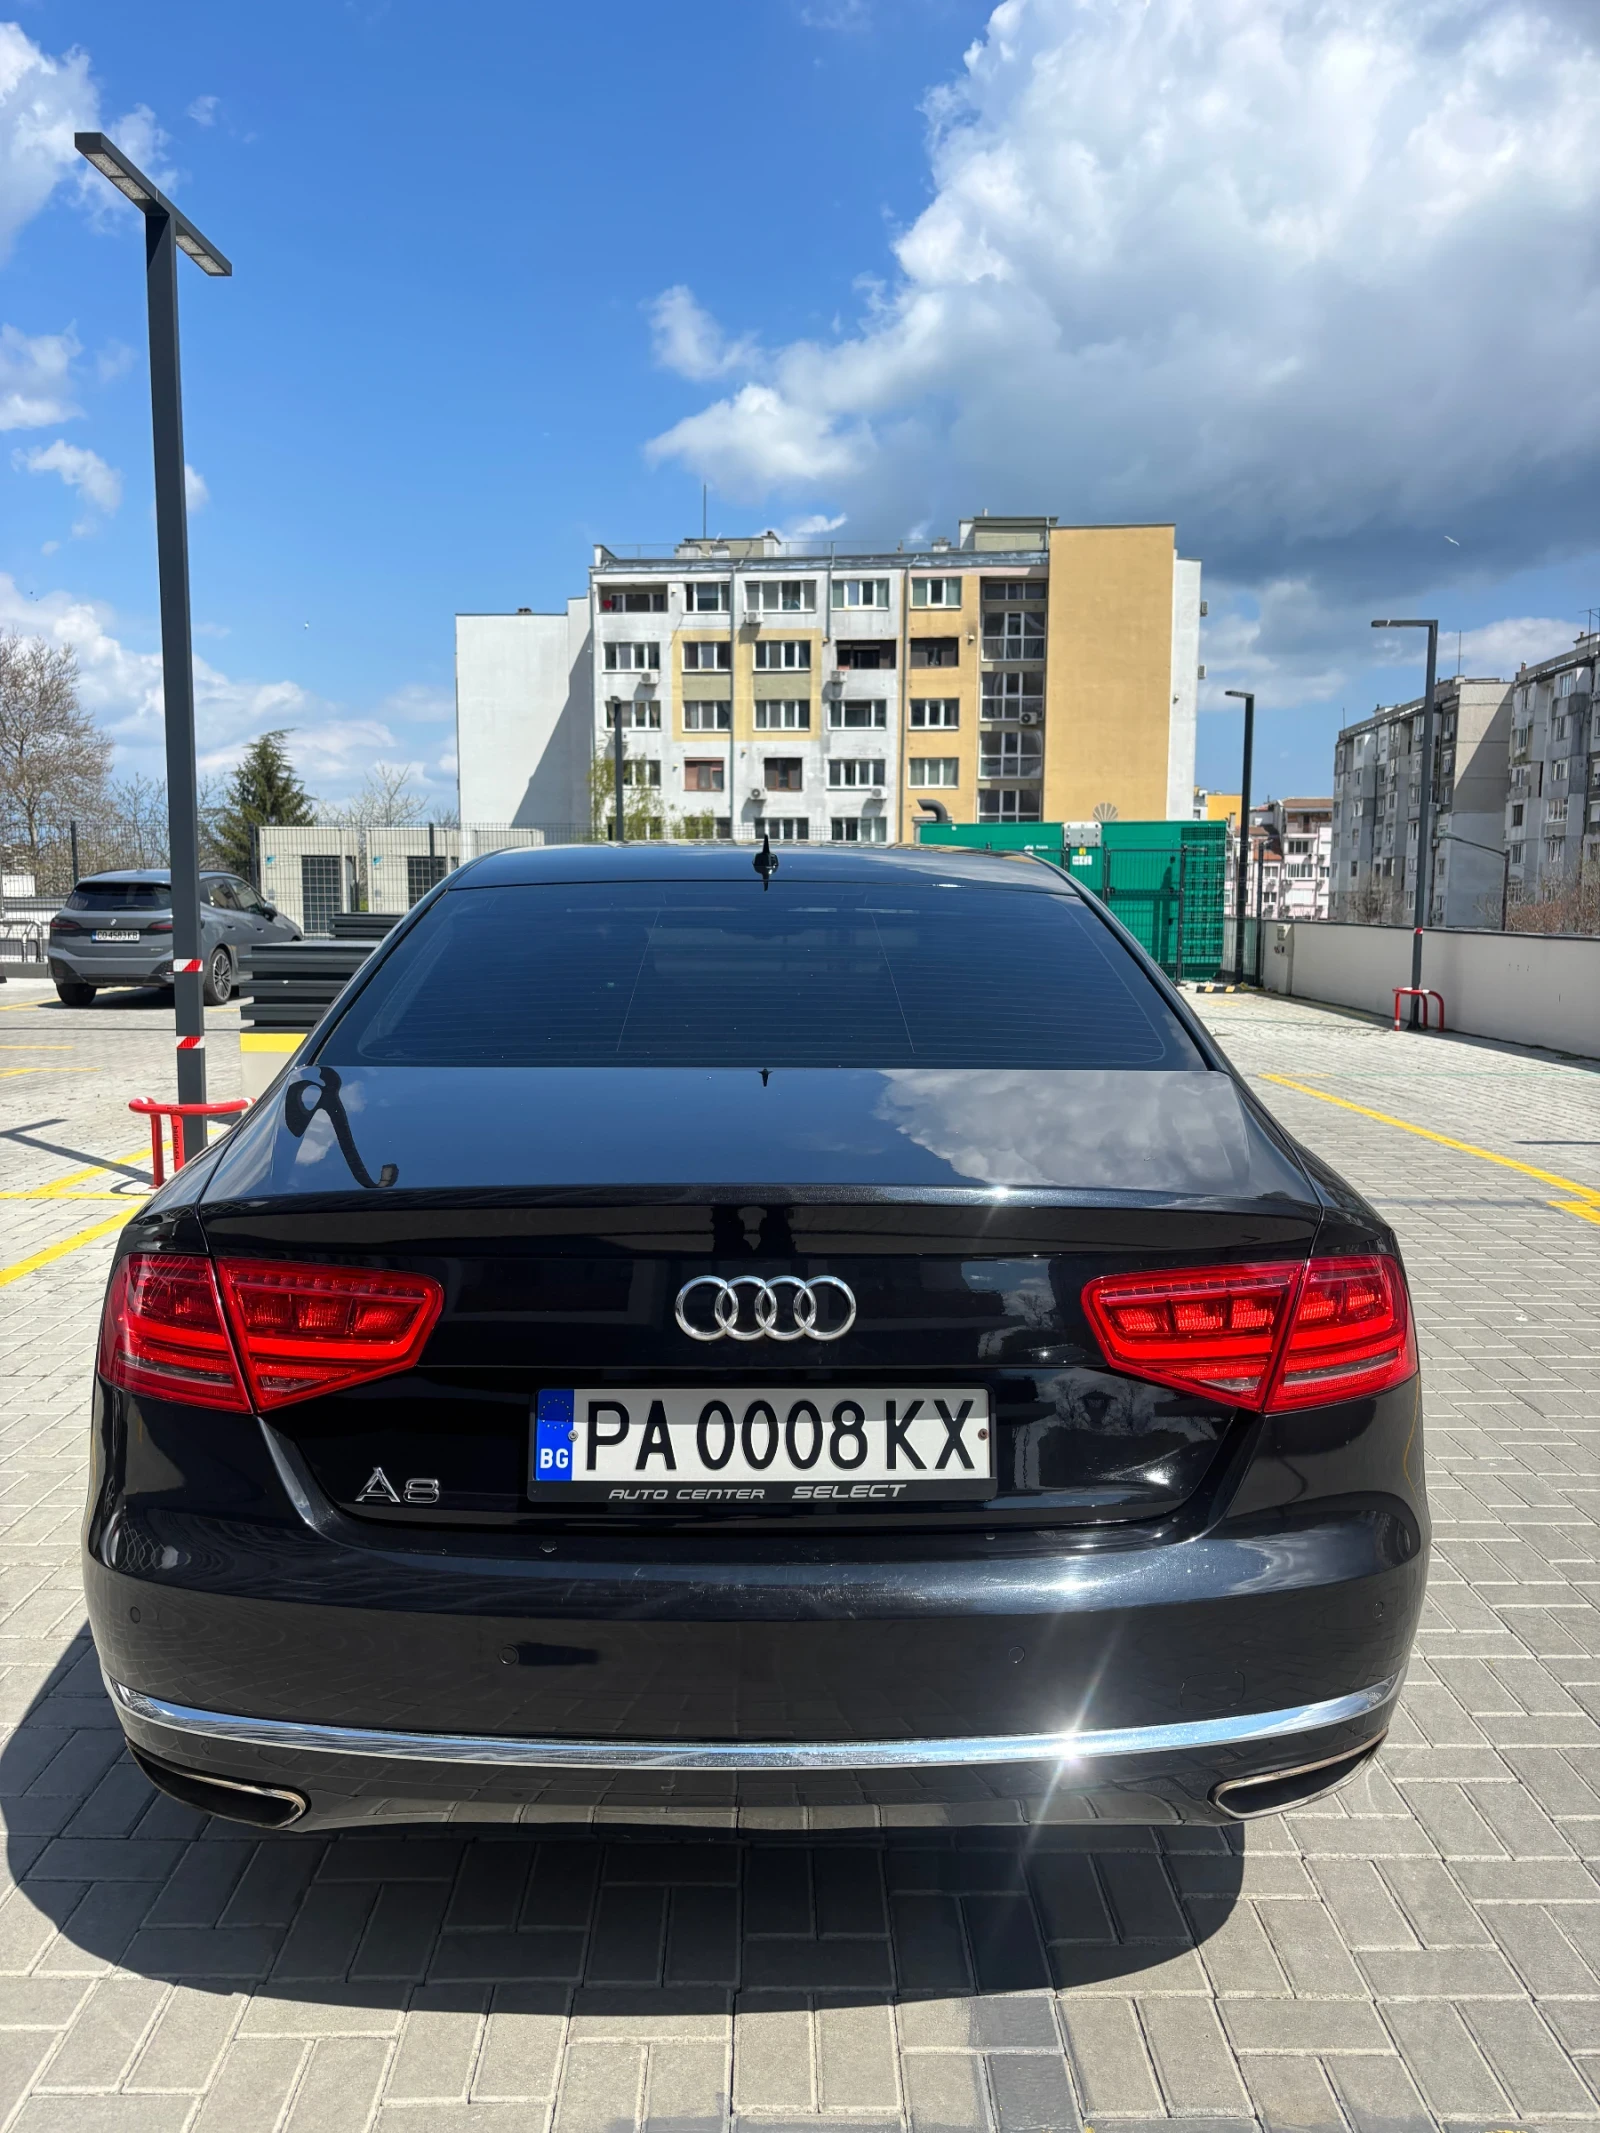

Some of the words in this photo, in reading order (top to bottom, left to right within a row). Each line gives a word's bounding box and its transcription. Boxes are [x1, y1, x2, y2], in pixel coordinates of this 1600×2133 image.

[586, 1399, 677, 1471] PA
[696, 1399, 868, 1470] 0008
[885, 1399, 975, 1470] KX
[540, 1448, 569, 1469] BG
[355, 1466, 440, 1504] A8
[608, 1489, 669, 1500] AUTO
[676, 1488, 766, 1500] CENTER
[791, 1484, 907, 1500] SELECT
